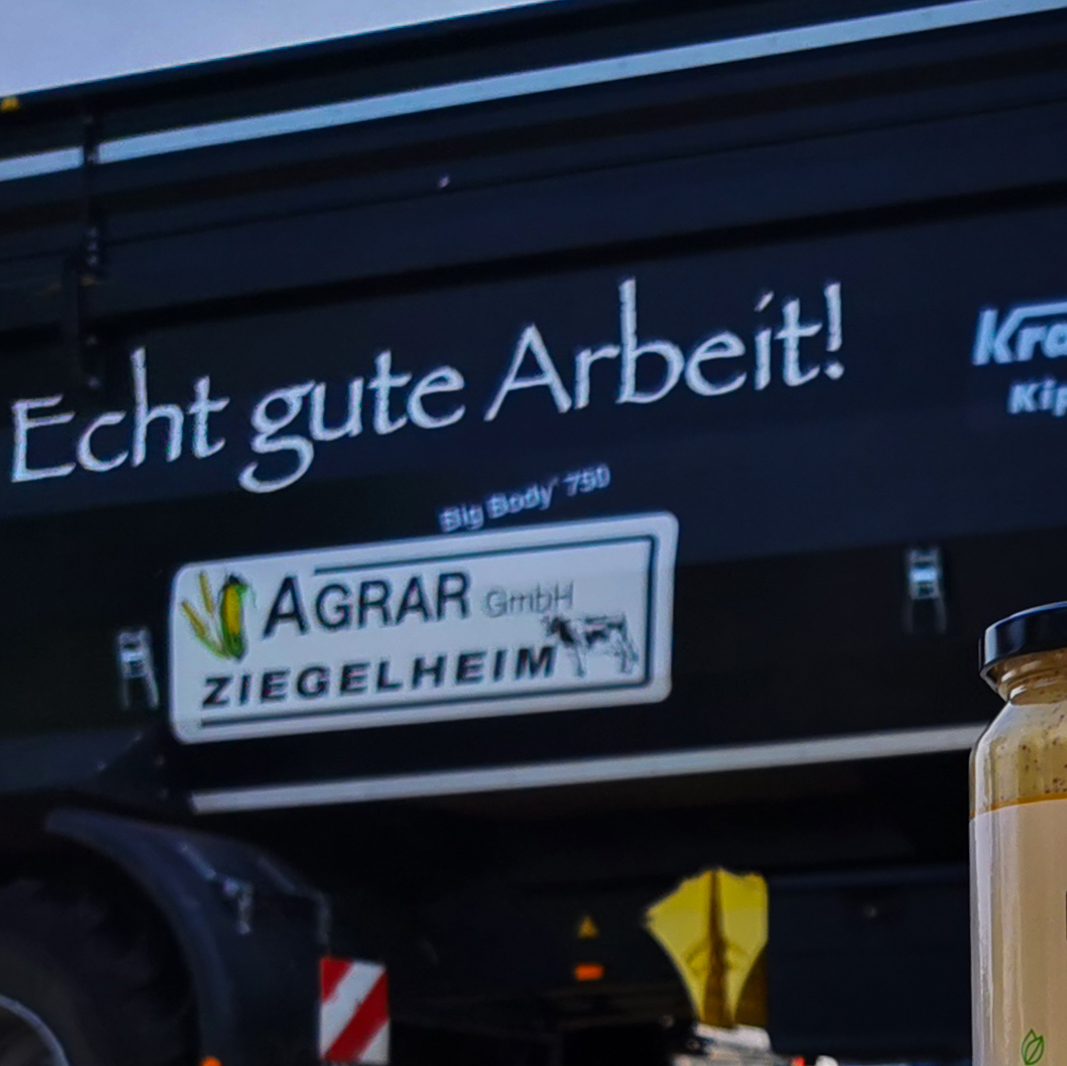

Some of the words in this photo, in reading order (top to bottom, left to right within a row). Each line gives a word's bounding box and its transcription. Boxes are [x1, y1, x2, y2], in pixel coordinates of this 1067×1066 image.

[10, 346, 230, 483] Echt
[238, 350, 467, 494] gute
[484, 277, 846, 422] Arbeit!
[439, 505, 484, 532] Big
[262, 571, 472, 638] AGRAR
[483, 580, 574, 618] GmbH
[201, 645, 557, 709] ZIEGELHEIM
